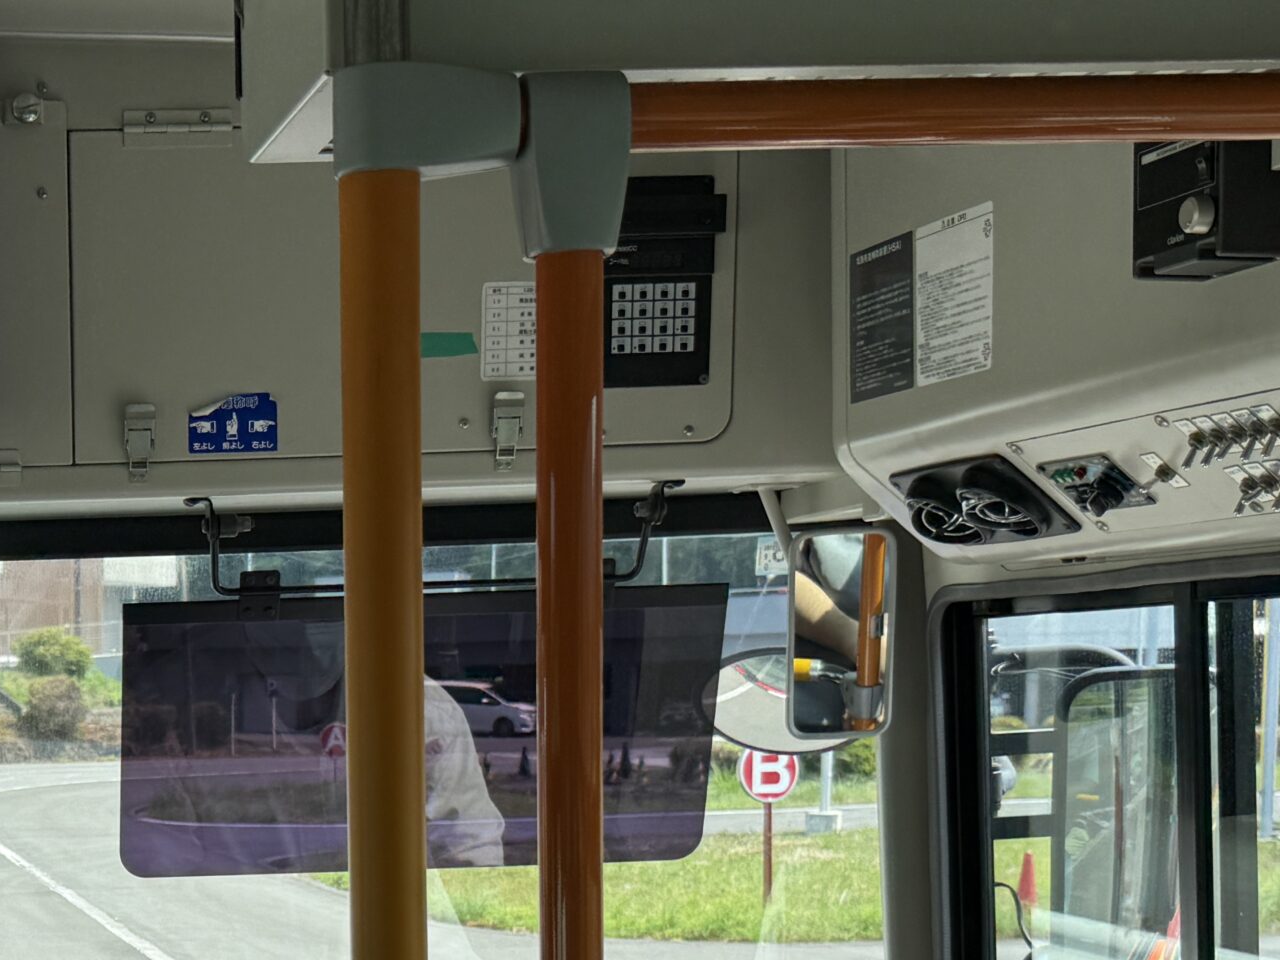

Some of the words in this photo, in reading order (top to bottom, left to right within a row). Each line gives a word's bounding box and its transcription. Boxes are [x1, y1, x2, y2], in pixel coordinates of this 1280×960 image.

[193, 442, 215, 450] 左よし
[222, 441, 244, 450] 前よし
[251, 440, 274, 449] 右よし
[325, 726, 346, 751] A
[752, 751, 791, 795] B
